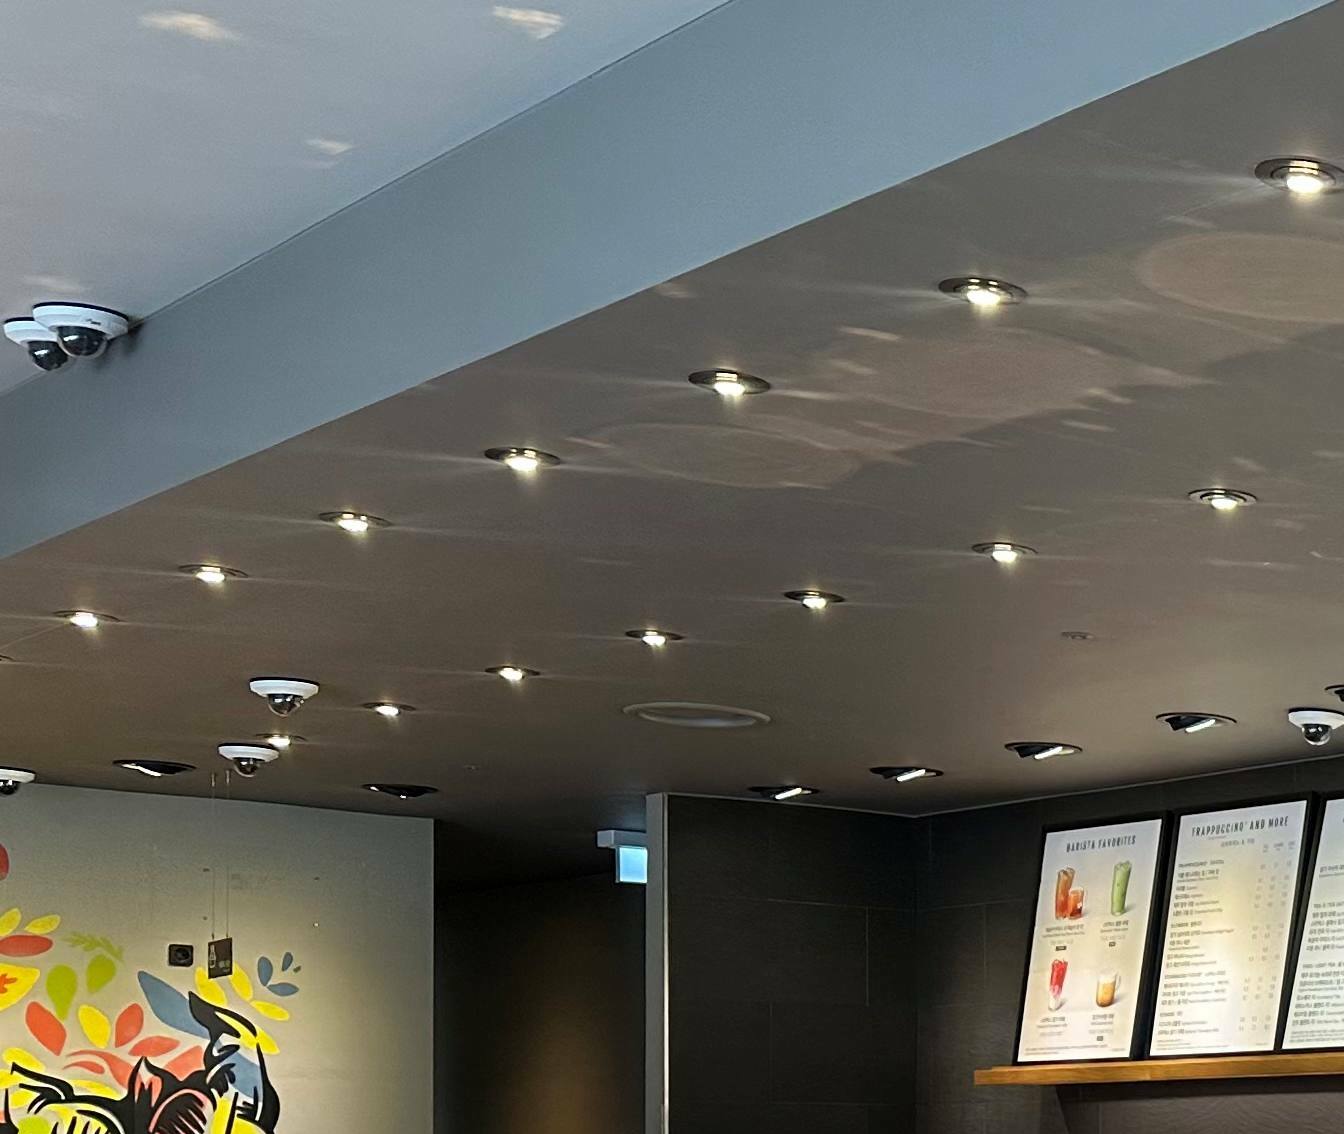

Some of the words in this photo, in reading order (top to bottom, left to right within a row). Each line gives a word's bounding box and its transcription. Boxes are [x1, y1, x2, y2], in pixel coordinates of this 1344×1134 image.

[1249, 818, 1266, 831] AND
[1268, 816, 1289, 829] MORE
[1066, 839, 1096, 852] BARISTA
[1098, 835, 1137, 849] FAVORITES
